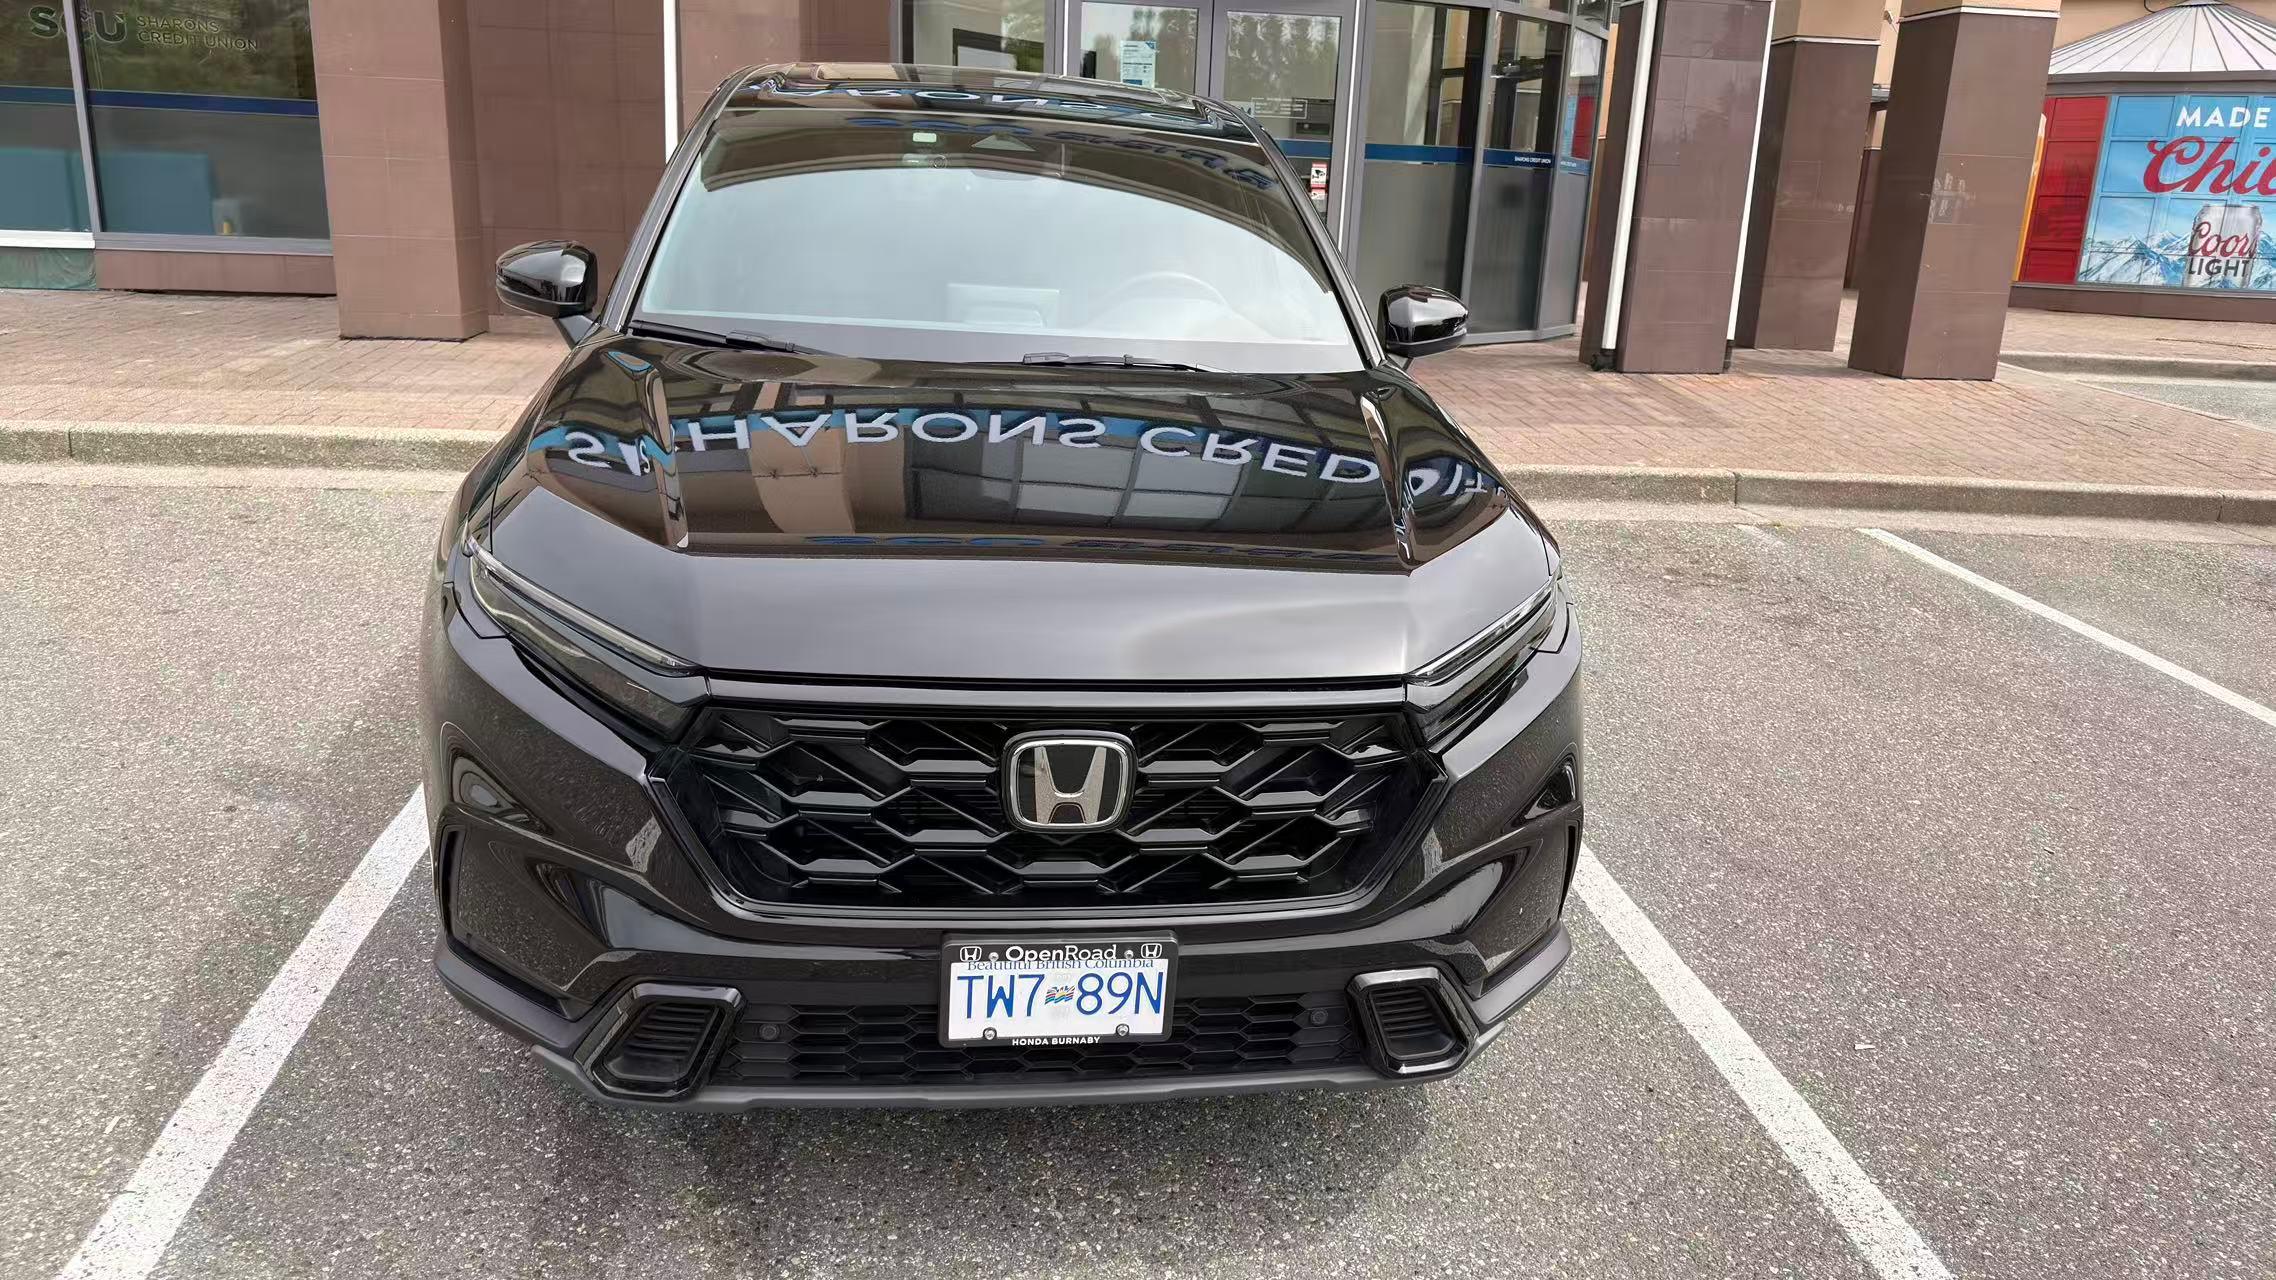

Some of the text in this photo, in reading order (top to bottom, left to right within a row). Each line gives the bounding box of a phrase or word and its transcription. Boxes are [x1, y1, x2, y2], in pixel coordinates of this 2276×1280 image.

[136, 16, 222, 33] SHARONS
[137, 31, 257, 50] CREDIT UNION
[2176, 106, 2271, 128] MADE
[2188, 258, 2250, 278] LIGHT
[1005, 944, 1117, 961] OpenRoad
[968, 957, 1154, 971] Beautiful British Columbia
[957, 972, 1163, 1018] TW7 89N
[1012, 1036, 1100, 1046] HONDA BURNABY
